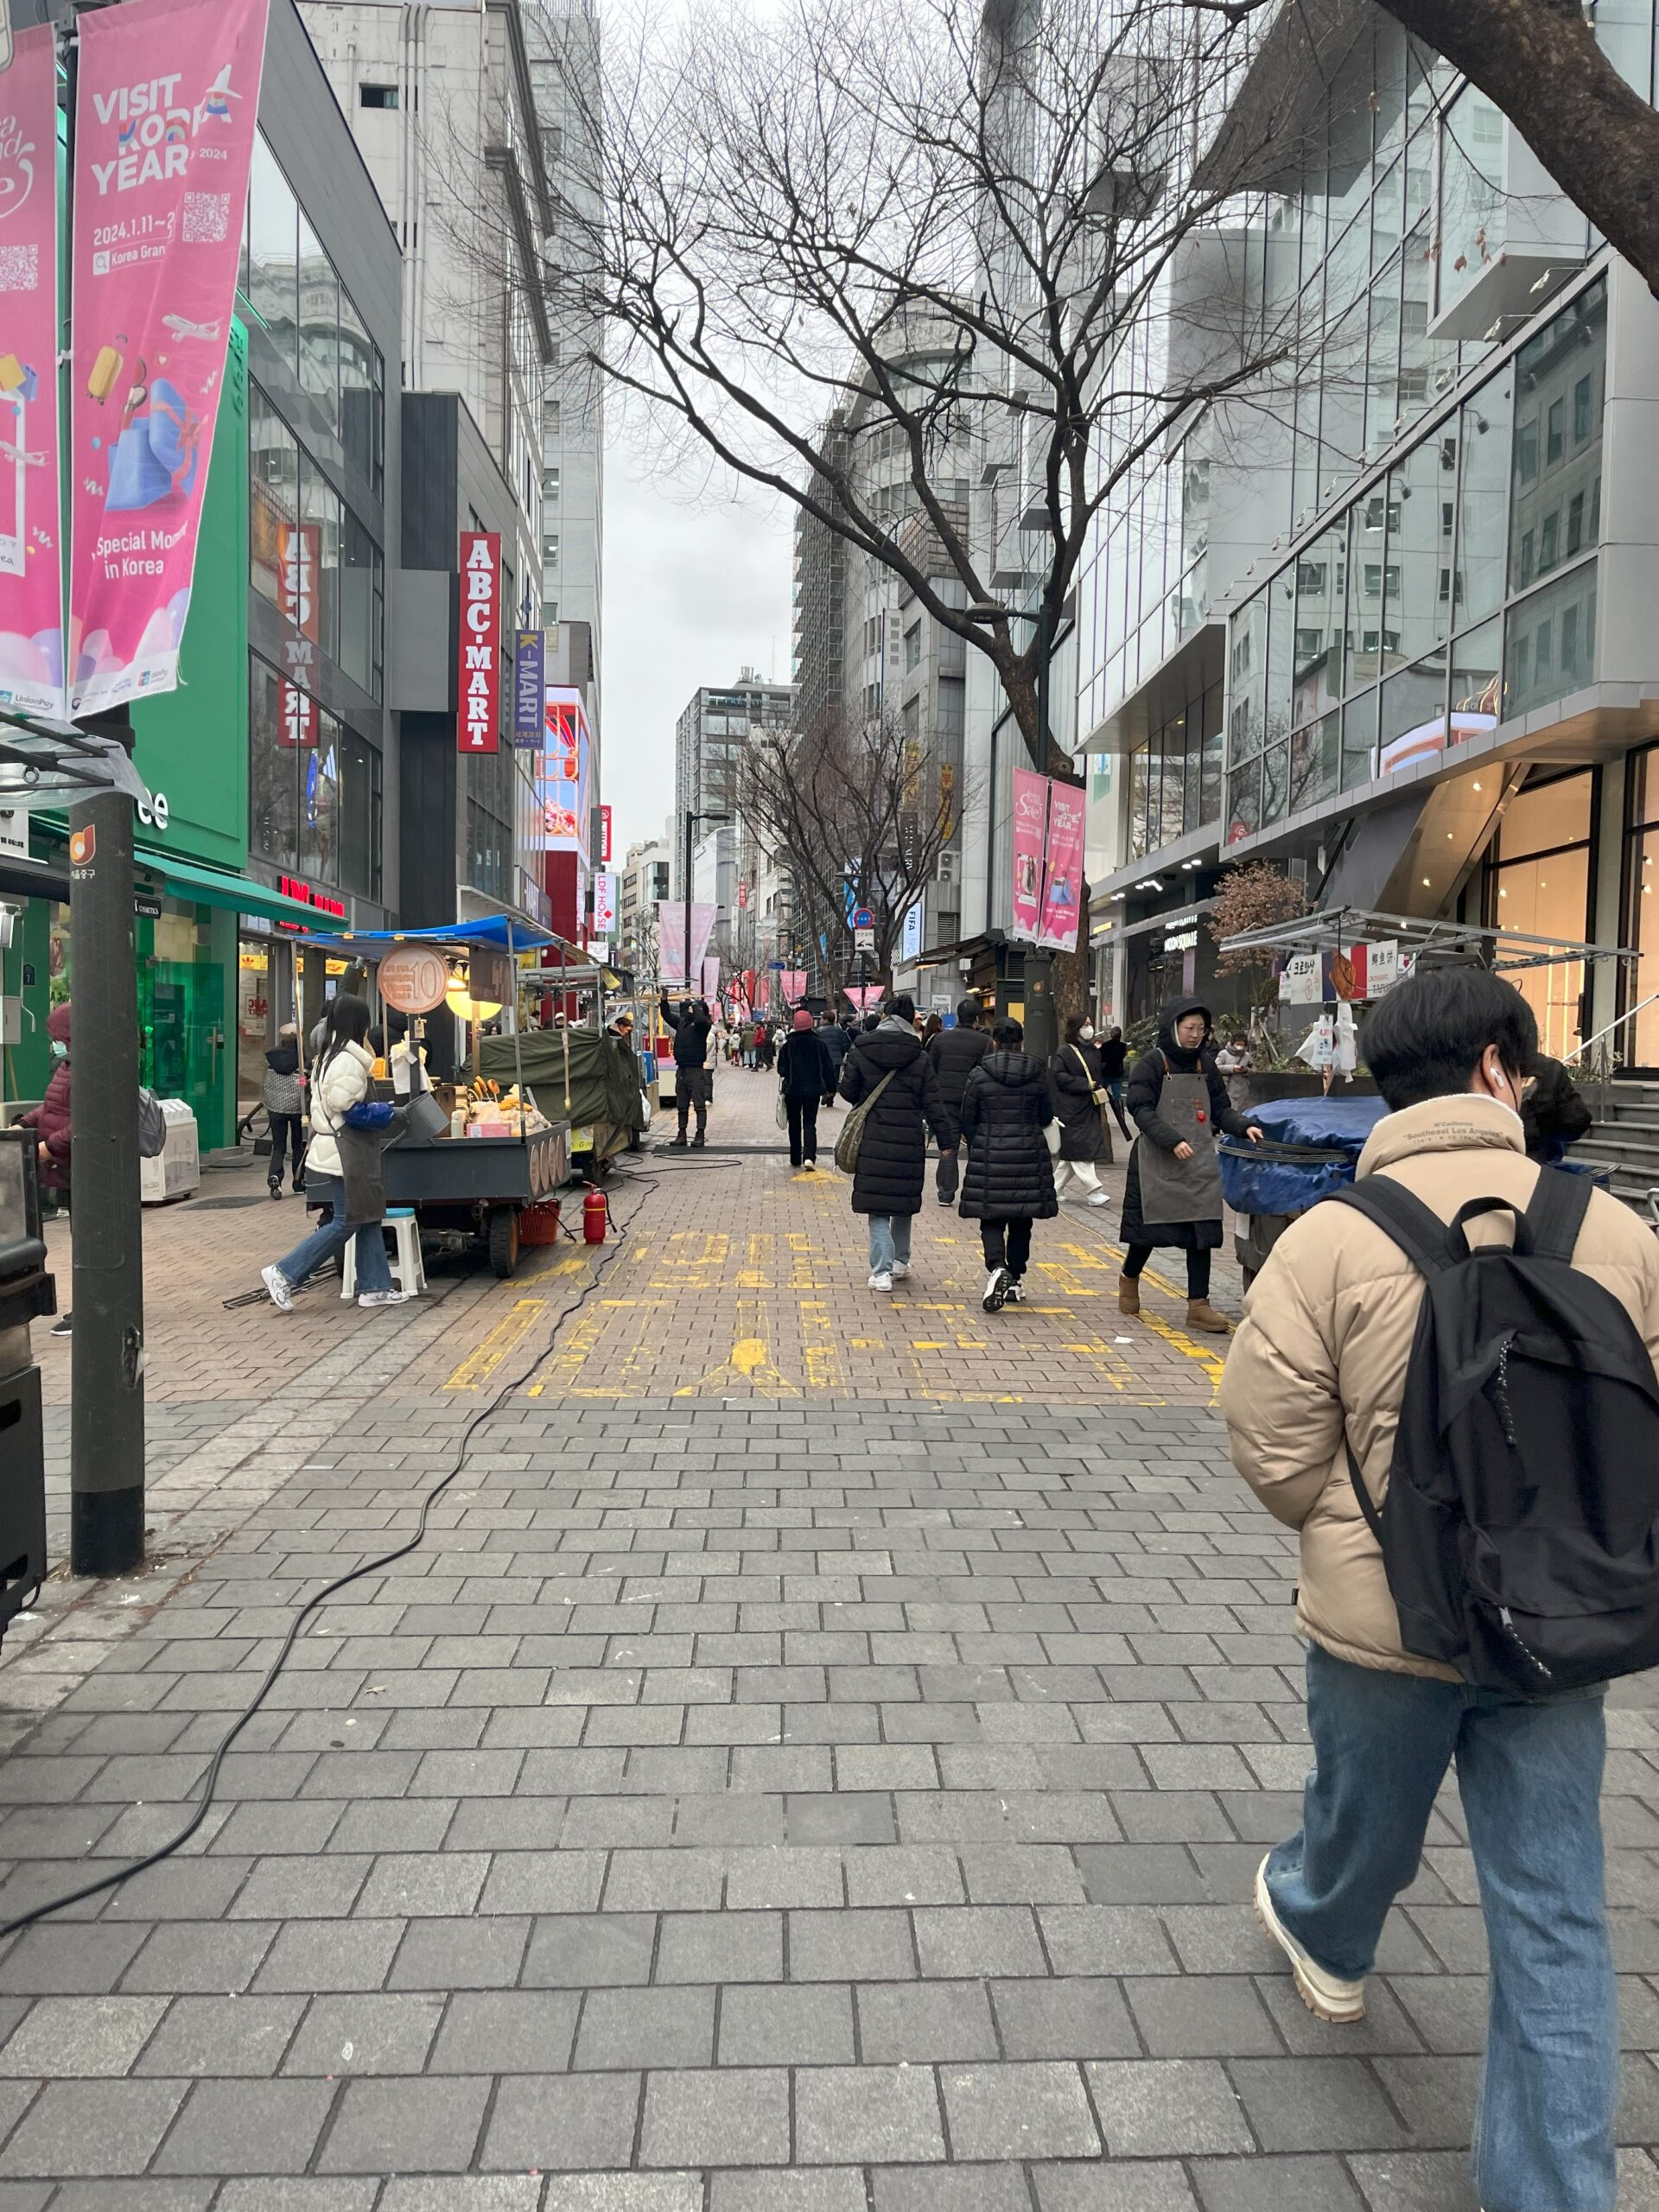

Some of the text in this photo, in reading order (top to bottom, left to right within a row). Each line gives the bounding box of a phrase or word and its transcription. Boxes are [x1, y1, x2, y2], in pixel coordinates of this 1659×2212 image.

[92, 73, 181, 124] VISIT
[91, 143, 189, 195] YEAR
[111, 245, 165, 264] Korea Gran
[97, 528, 145, 556] Special
[105, 557, 163, 579] in Korea
[518, 634, 538, 728] K-MART
[15, 694, 54, 709] UnionPay
[410, 961, 437, 1000] 10
[1294, 957, 1315, 976] 크로와상
